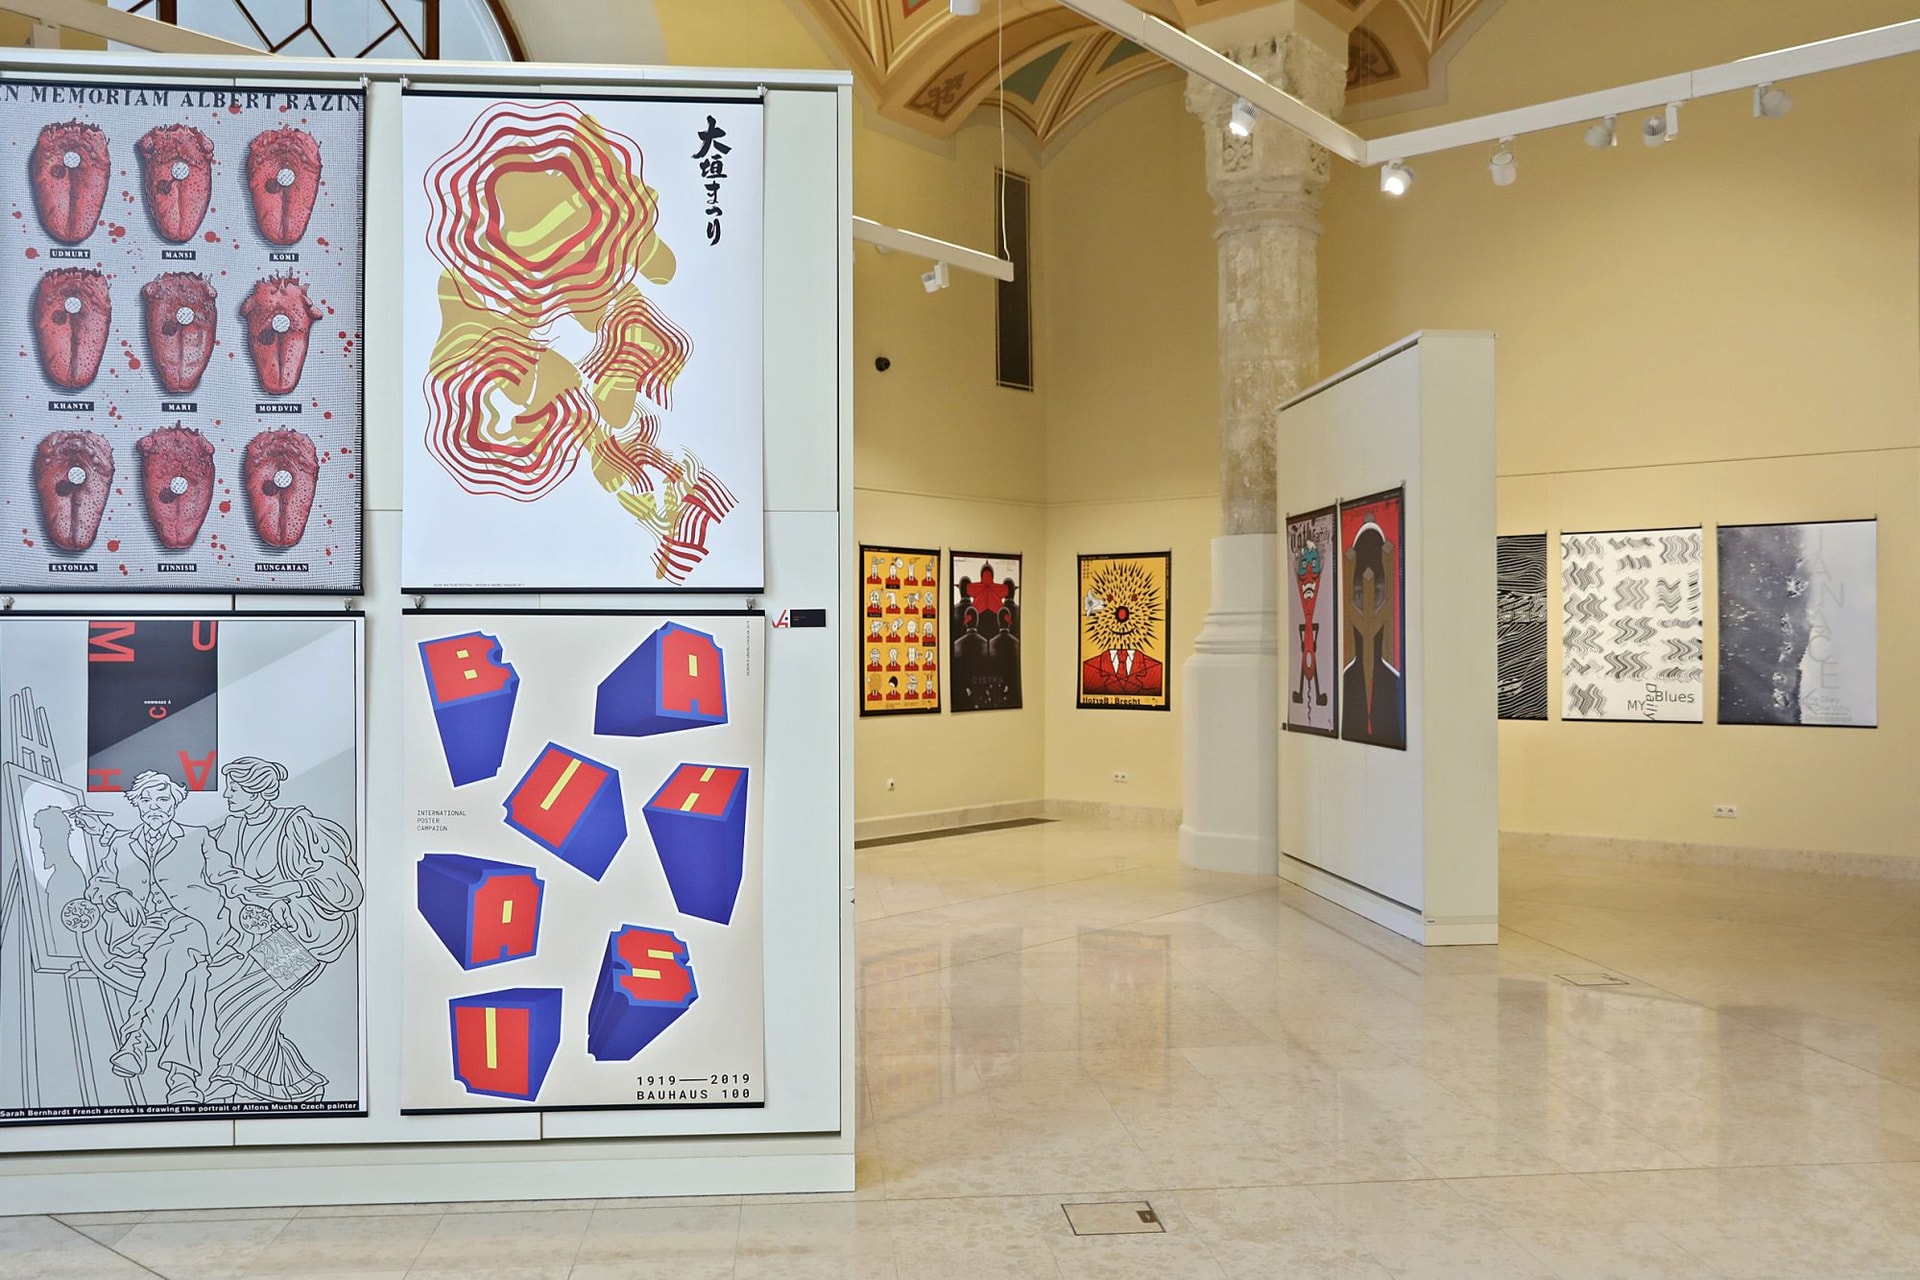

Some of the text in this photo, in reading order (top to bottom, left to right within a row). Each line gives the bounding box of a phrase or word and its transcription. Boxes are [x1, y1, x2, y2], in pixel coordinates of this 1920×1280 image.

[31, 85, 169, 107] MEMORIAM
[180, 91, 276, 110] ALBERT
[286, 93, 360, 112] RAZIN
[692, 115, 732, 246] 大垣まつり
[51, 250, 296, 261] UDMURT MANSI KOMI
[53, 402, 299, 412] KHANTY MARI MORDVIN
[52, 563, 308, 572] ESTONIAN FINNISH HUNGARIAN
[1114, 697, 1140, 705] Brecht
[1627, 682, 1695, 720] MY Daily Blues
[636, 1088, 750, 1100] BAUHAUS 100
[0, 1110, 25, 1118] Sarah
[28, 1109, 71, 1117] Bernhardt
[72, 1108, 101, 1116] French
[136, 1106, 145, 1114] is
[146, 1105, 180, 1115] drawing
[198, 1104, 230, 1113] portrait
[231, 1103, 241, 1111] of
[242, 1103, 269, 1111] Alfons
[300, 1102, 325, 1110] Czech
[327, 1101, 357, 1111] painter
